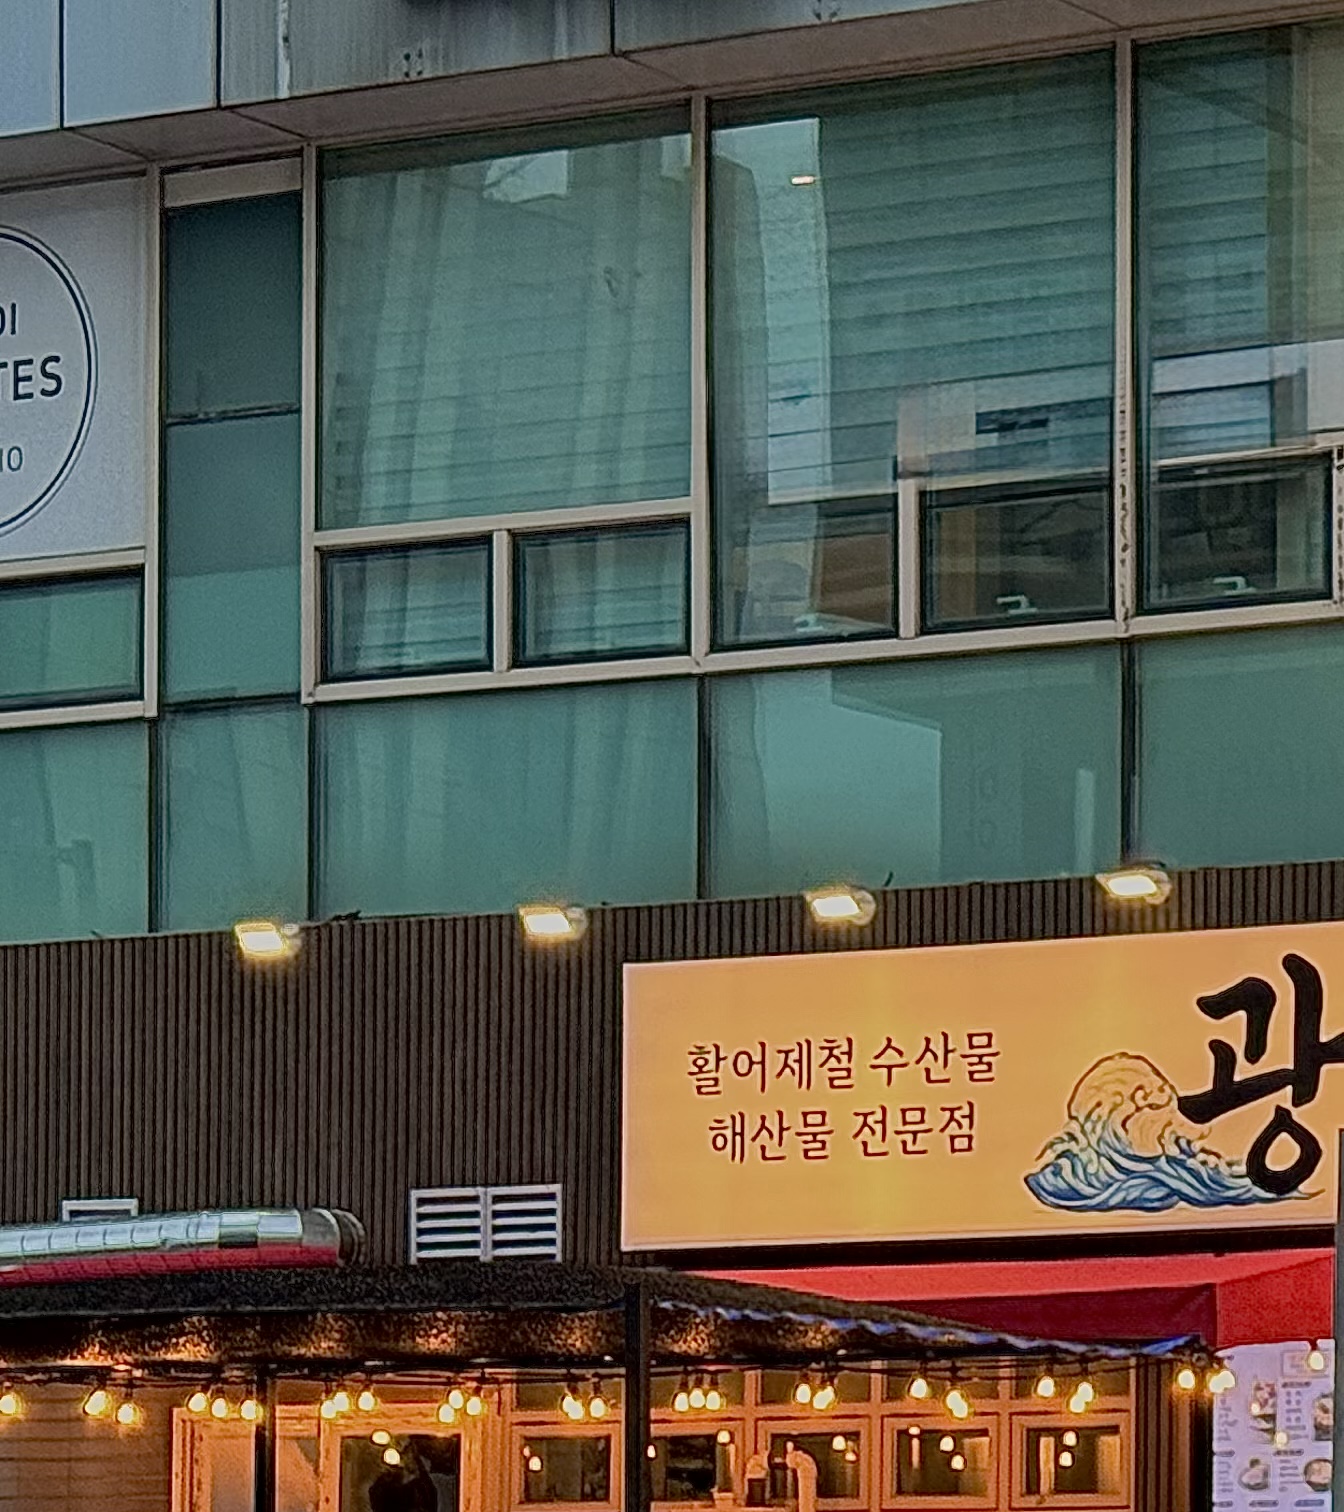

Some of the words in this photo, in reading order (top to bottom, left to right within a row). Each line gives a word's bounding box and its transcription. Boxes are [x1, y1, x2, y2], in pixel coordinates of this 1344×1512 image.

[687, 1036, 855, 1096] 활어제철
[868, 1030, 1001, 1088] 수산물
[708, 1109, 835, 1165] 해산물
[852, 1099, 975, 1158] 전문점
